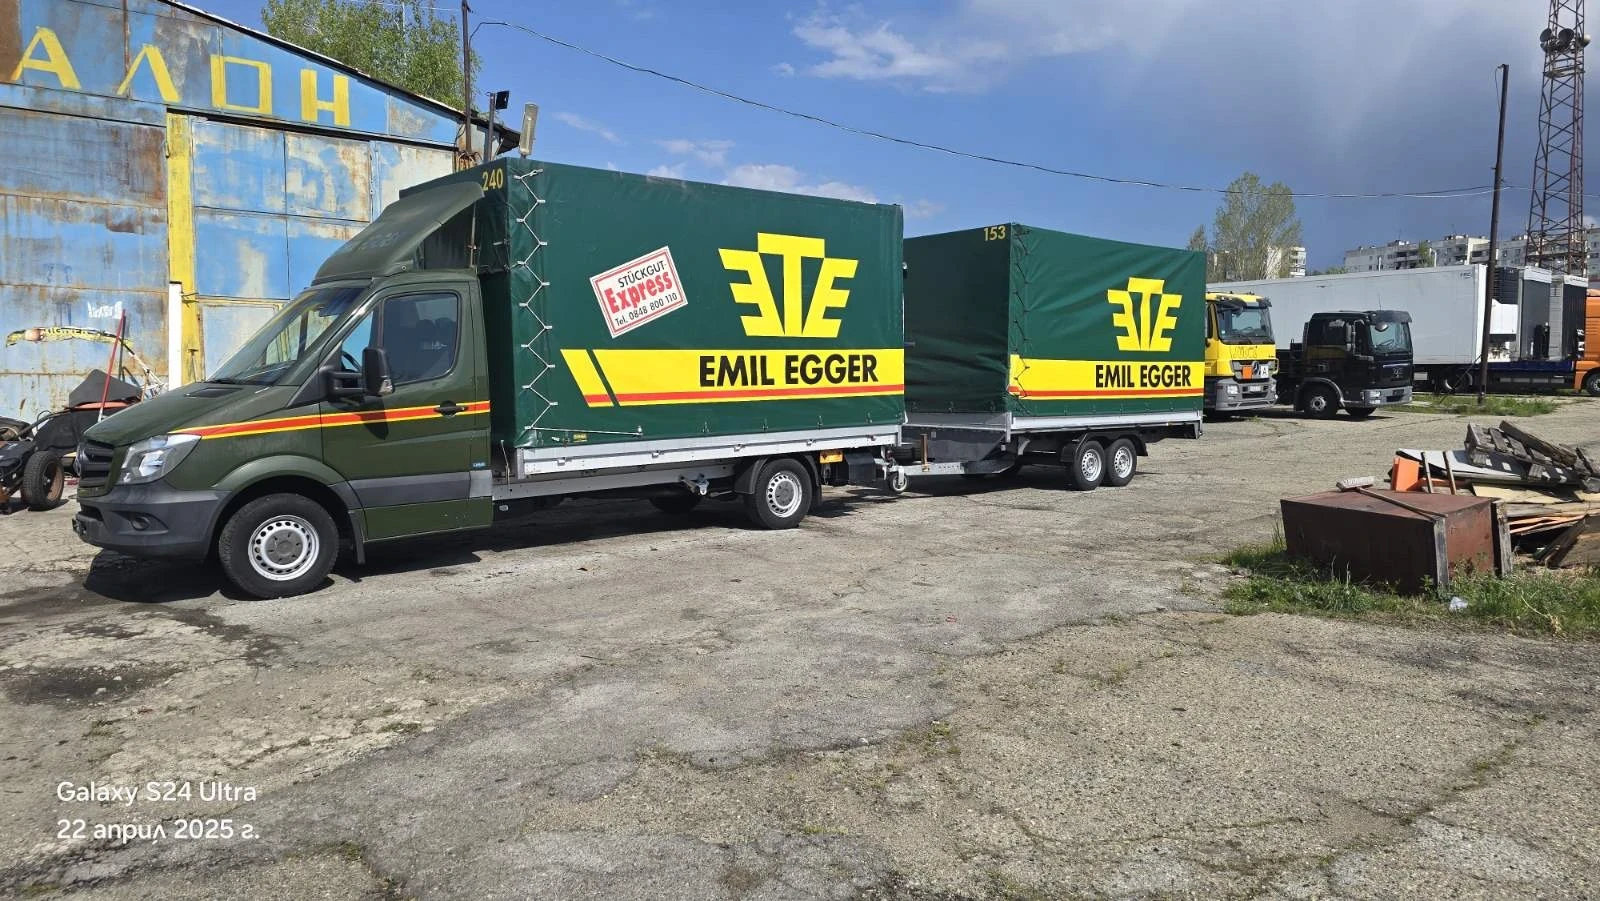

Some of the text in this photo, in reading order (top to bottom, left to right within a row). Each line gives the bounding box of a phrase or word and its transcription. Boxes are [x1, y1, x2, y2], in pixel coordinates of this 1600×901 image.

[482, 168, 503, 191] 240
[984, 225, 1006, 241] 153
[604, 271, 673, 314] Express
[615, 292, 678, 326] Tel. 0848 800 110
[700, 354, 879, 387] EMIL EGGER
[1095, 364, 1191, 388] EMIL EGGER
